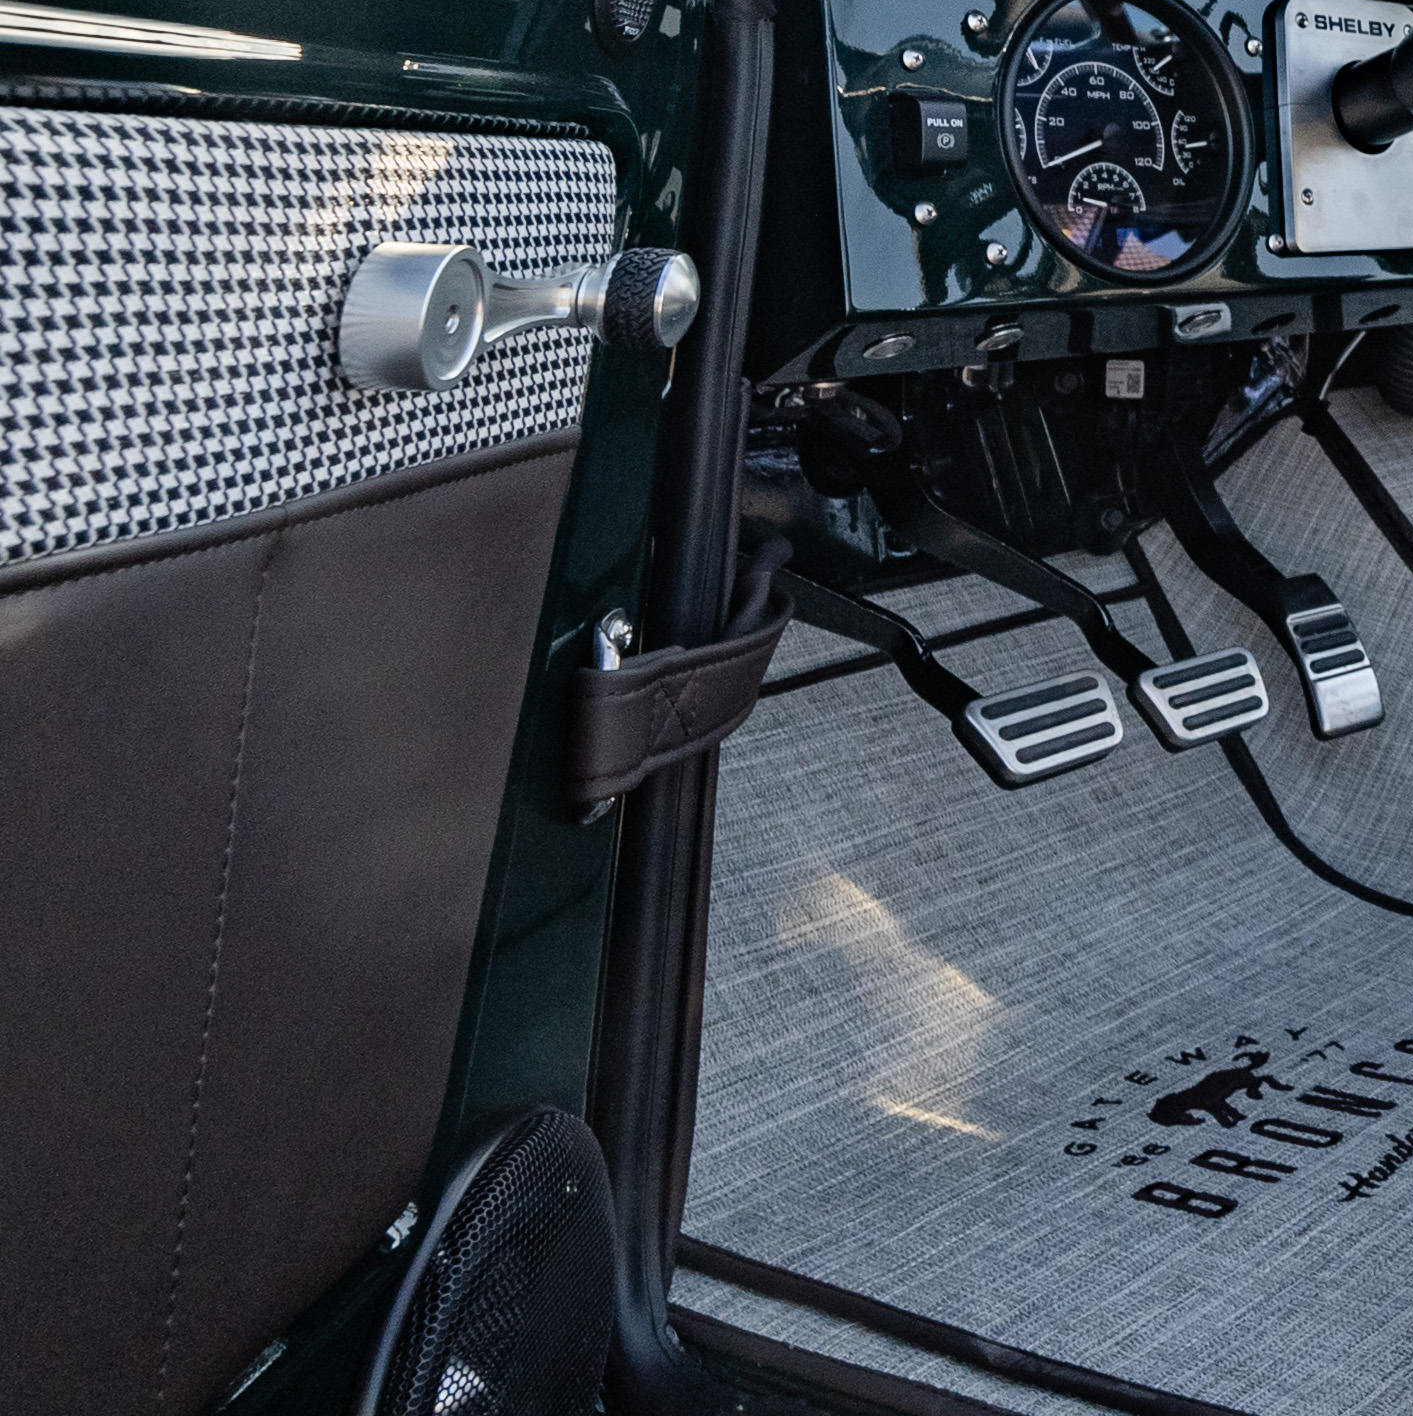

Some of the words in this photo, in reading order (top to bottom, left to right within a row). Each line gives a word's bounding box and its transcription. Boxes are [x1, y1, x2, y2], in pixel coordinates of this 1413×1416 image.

[1314, 14, 1396, 38] SHELBY
[1111, 43, 1131, 51] TEMP
[1089, 76, 1105, 86] 60
[1061, 87, 1077, 97] 40
[1087, 90, 1111, 100] MPH
[1119, 90, 1135, 100] 80
[926, 117, 950, 128] PULL
[950, 118, 964, 128] ON
[1048, 117, 1065, 127] 20
[1132, 120, 1151, 130] 100
[1182, 151, 1192, 159] 30
[1134, 157, 1153, 167] 120
[1091, 174, 1098, 182] 3
[1101, 171, 1108, 179] 4
[1112, 174, 1119, 182] 5
[1082, 181, 1089, 189] 2
[1097, 182, 1115, 191] RPM
[1122, 181, 1129, 189] 6
[1172, 178, 1186, 186] OIL
[1075, 206, 1083, 214] 0
[1300, 1041, 1346, 1062] '77
[1063, 1025, 1309, 1157] GATEWAY
